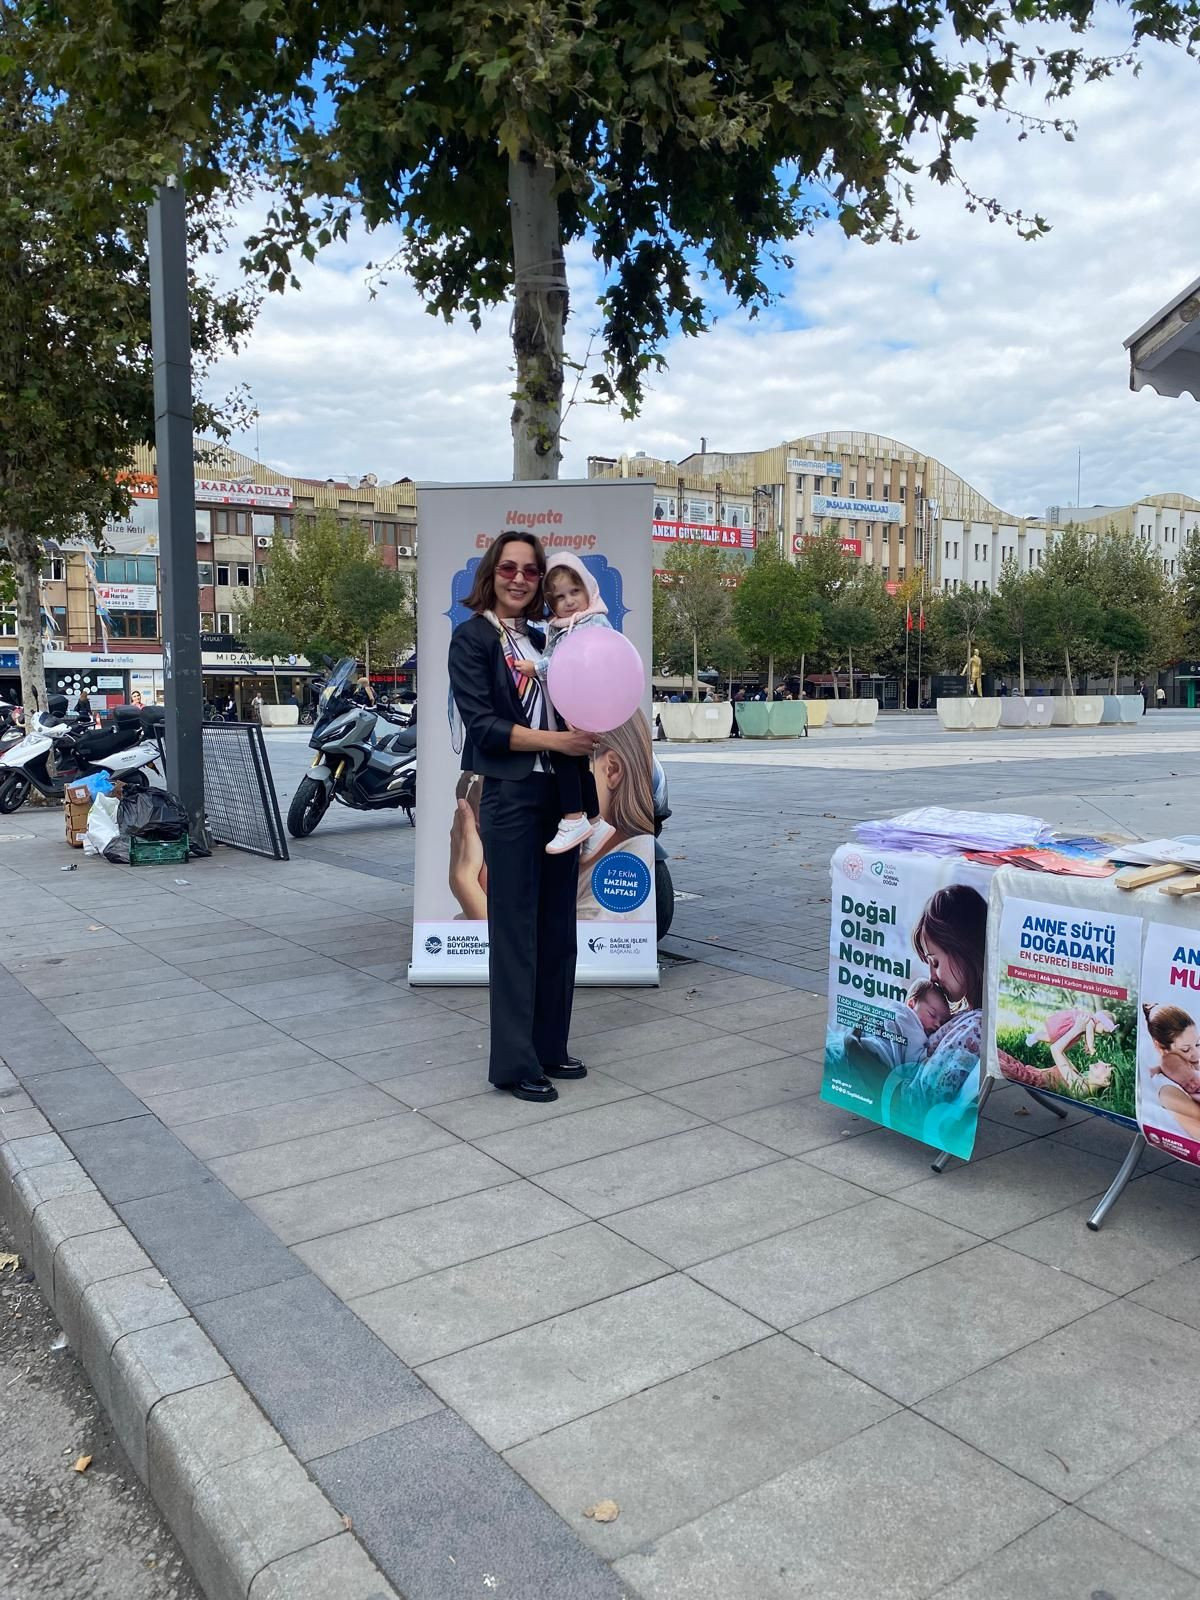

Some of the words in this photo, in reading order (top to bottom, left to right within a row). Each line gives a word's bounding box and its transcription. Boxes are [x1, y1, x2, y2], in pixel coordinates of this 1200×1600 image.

[201, 481, 291, 497] KARAKADILAR
[506, 509, 563, 528] Hayata
[603, 877, 639, 888] EMZİRME
[618, 870, 637, 879] EKİM
[603, 887, 637, 897] HAFTASI
[841, 895, 897, 925] Doğal
[840, 919, 885, 947] Olan
[1022, 915, 1068, 937] ANNE
[1071, 921, 1116, 945] SÜTÜ
[839, 942, 911, 980] Normal
[1020, 931, 1115, 966] DOĞADAKİ
[1172, 946, 1200, 966] AN
[1019, 951, 1031, 960] EN
[1033, 953, 1070, 969] ÇEVRECİ
[1071, 960, 1114, 977] BESİNDİR
[838, 966, 908, 1004] Doğum
